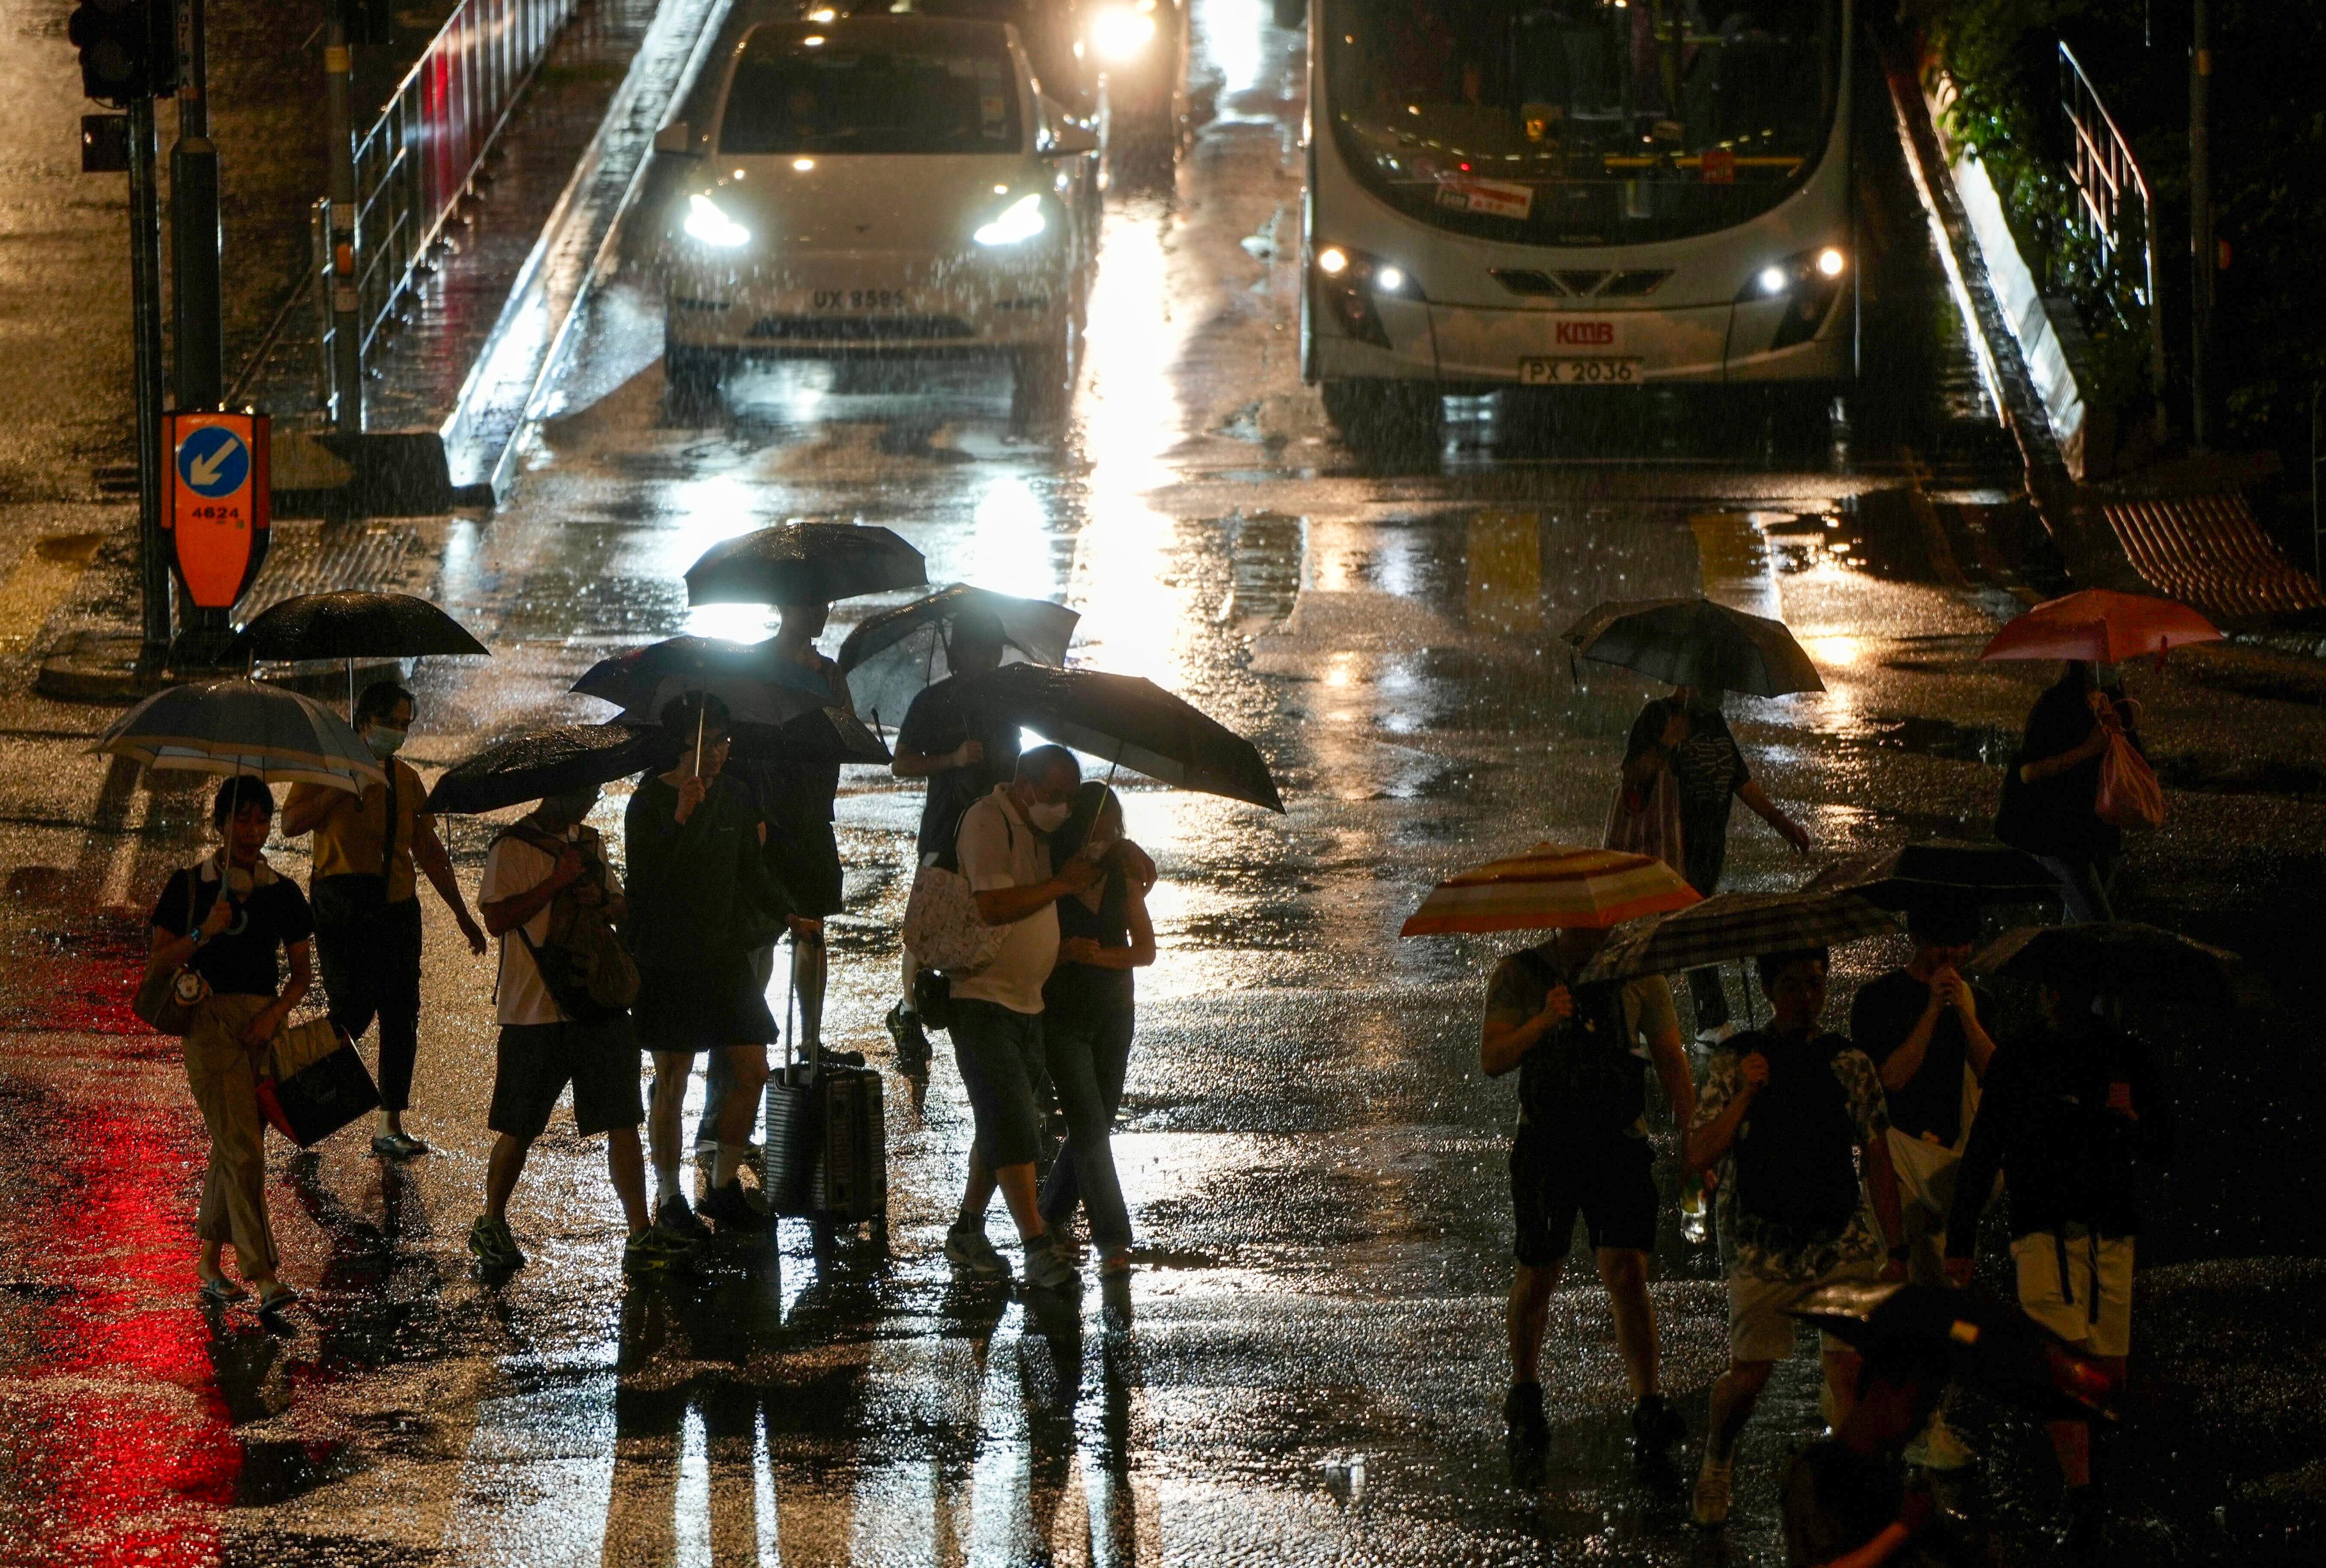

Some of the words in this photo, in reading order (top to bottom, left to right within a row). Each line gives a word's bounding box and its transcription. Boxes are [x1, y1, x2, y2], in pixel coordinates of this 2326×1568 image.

[814, 290, 842, 309] UX
[1555, 321, 1614, 345] KMB
[1529, 362, 1559, 382] PX
[1571, 362, 1633, 382] 2036
[192, 507, 239, 519] 4624
